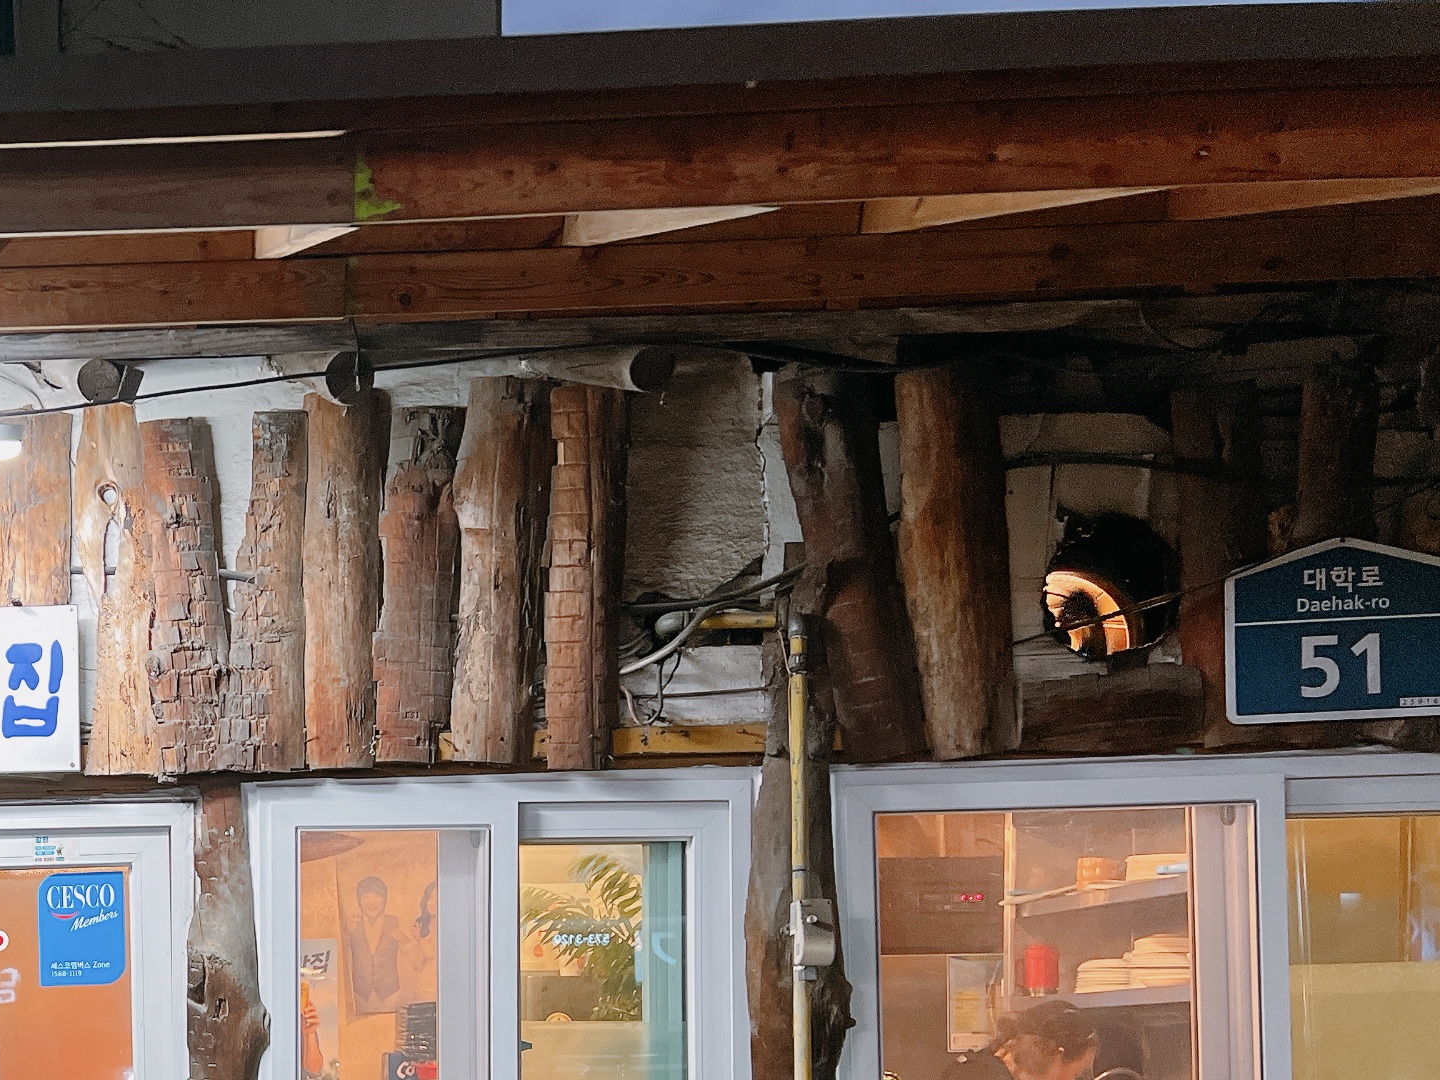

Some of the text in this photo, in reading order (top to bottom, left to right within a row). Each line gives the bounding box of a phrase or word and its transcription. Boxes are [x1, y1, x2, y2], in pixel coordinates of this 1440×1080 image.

[1303, 566, 1384, 592] 대학로
[1296, 595, 1391, 612] Daehak-ro
[1300, 632, 1382, 698] 51
[2, 638, 64, 738] 집
[46, 883, 115, 909] CESCO
[70, 908, 120, 932] Members
[92, 960, 111, 969] Zone
